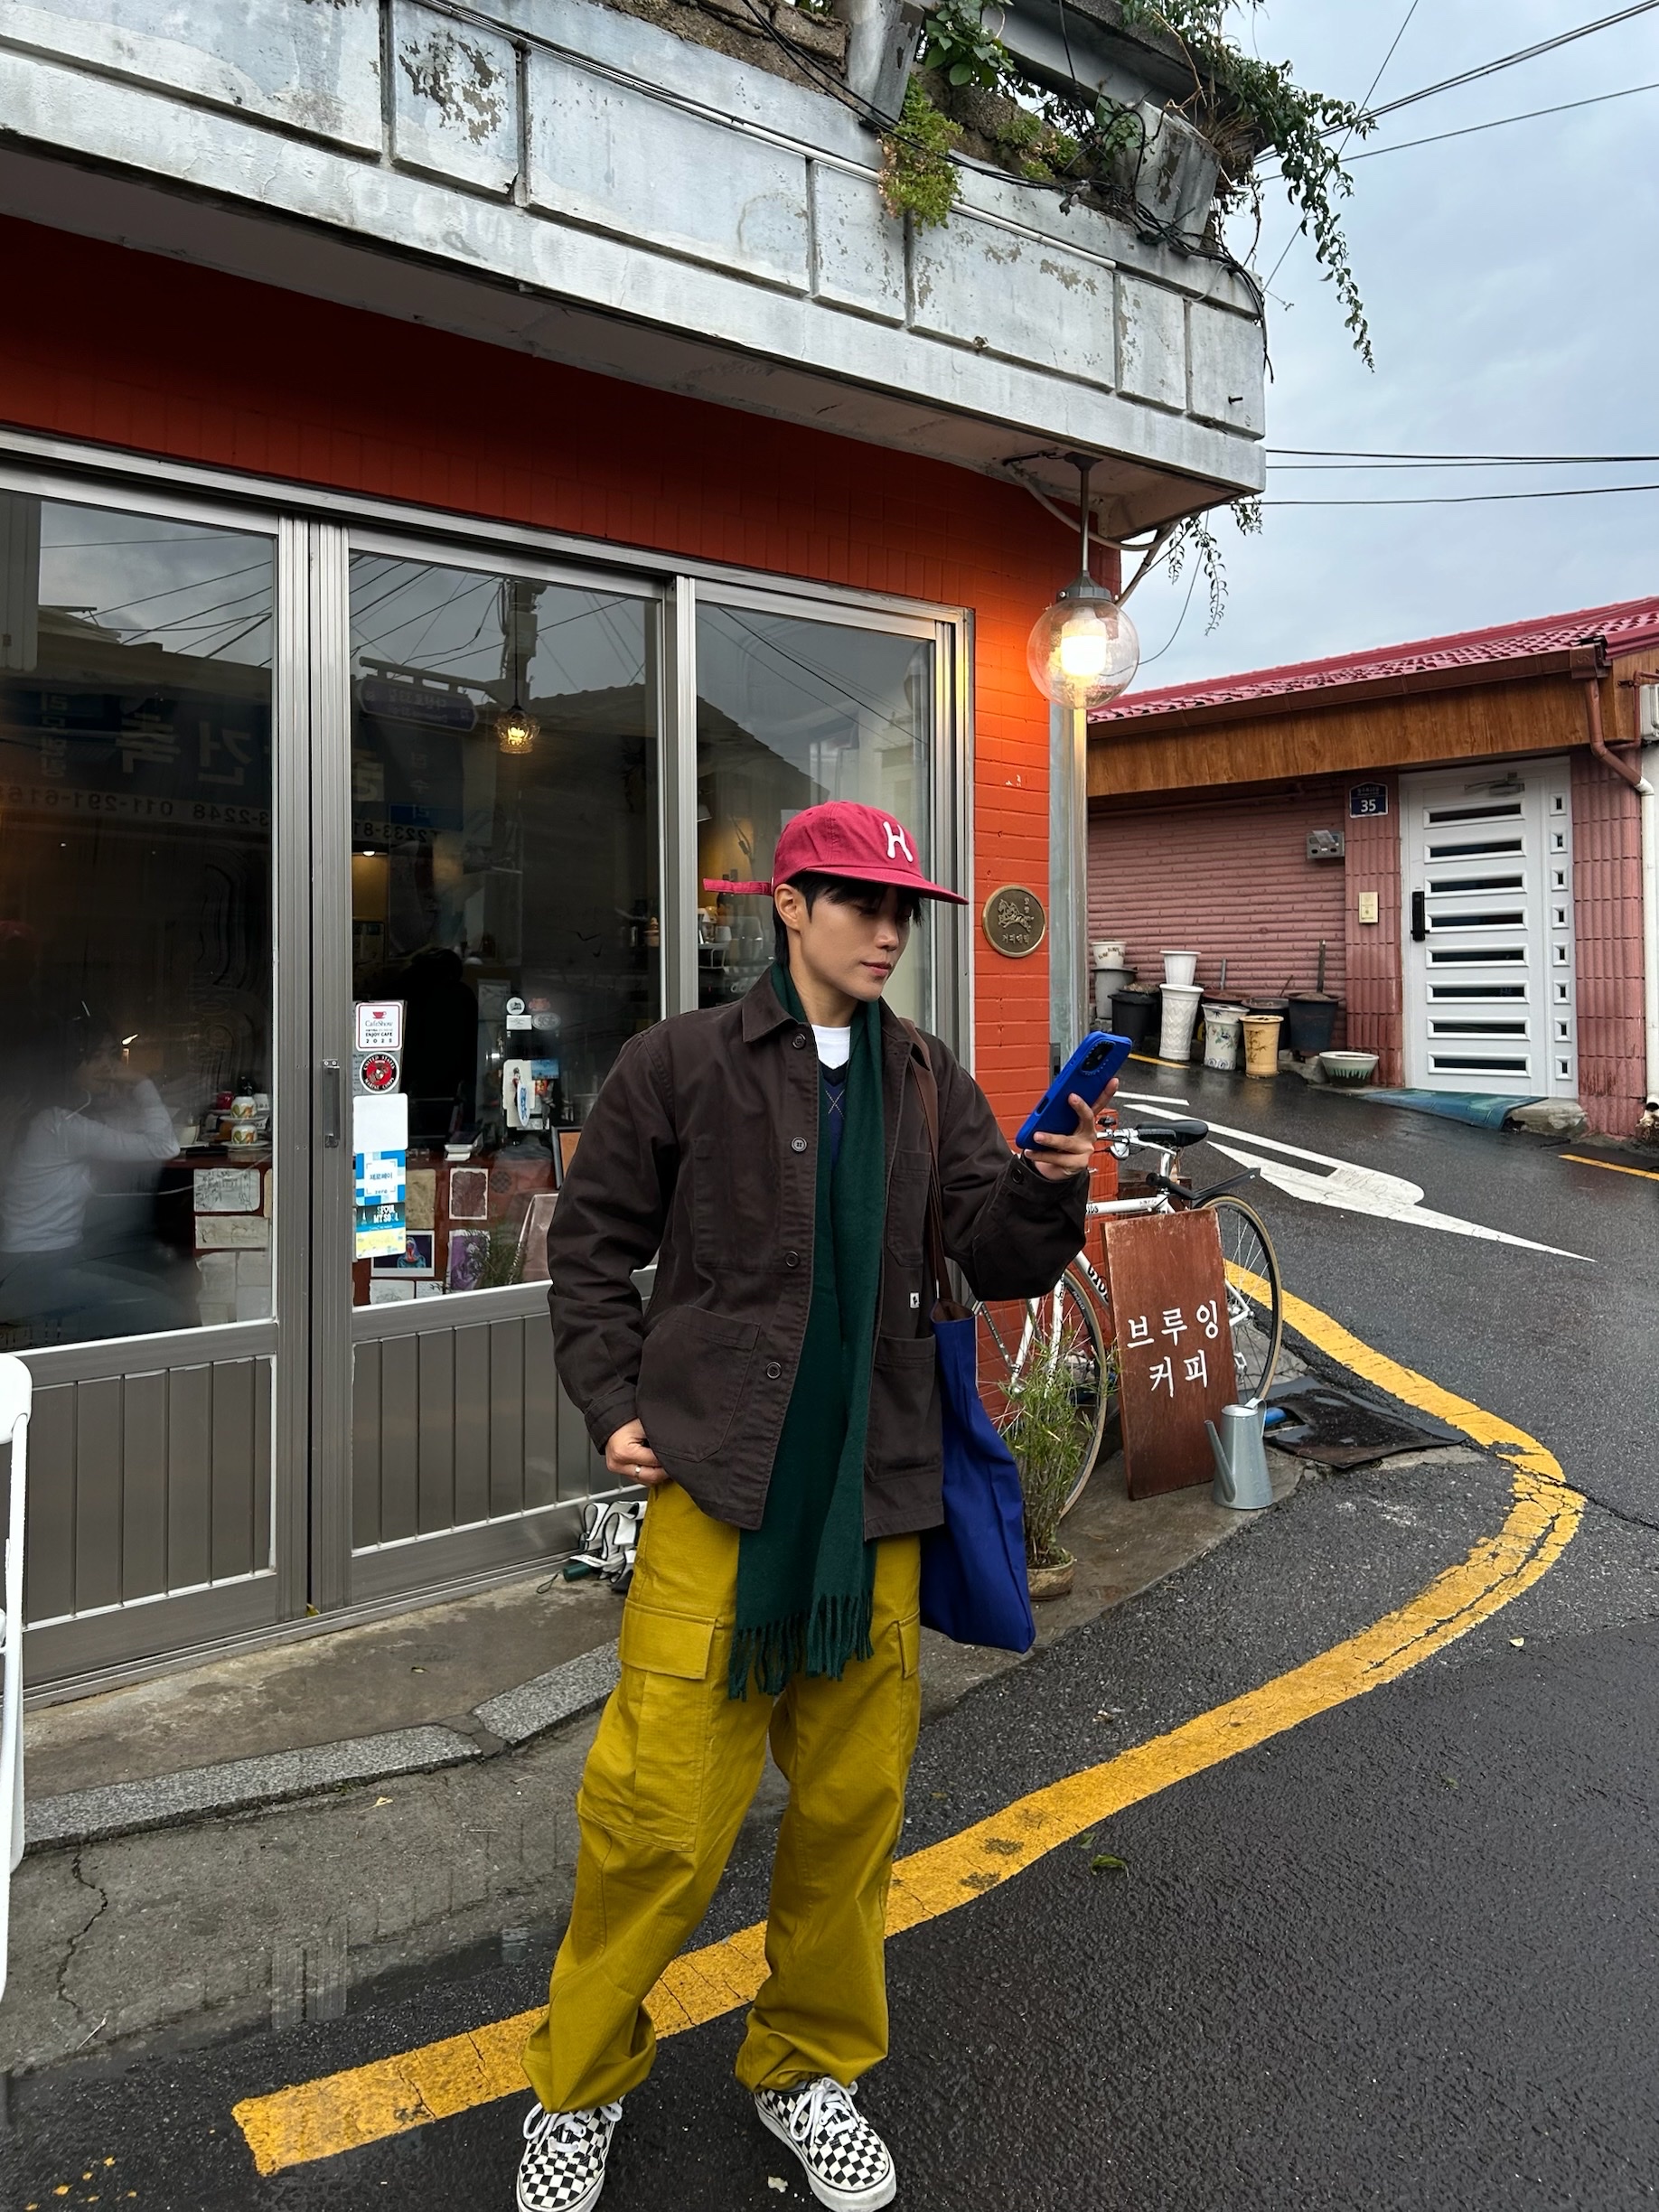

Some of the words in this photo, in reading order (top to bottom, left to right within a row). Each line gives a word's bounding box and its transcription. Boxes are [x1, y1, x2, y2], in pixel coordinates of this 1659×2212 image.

[1360, 799, 1376, 812] 35
[883, 820, 914, 863] H
[363, 1055, 380, 1070] UNITED
[381, 1055, 395, 1070] STATES
[370, 1173, 393, 1181] 제로페이
[373, 1214, 382, 1223] MY
[1126, 1299, 1220, 1349] 브루잉
[1148, 1349, 1209, 1399] 커피
